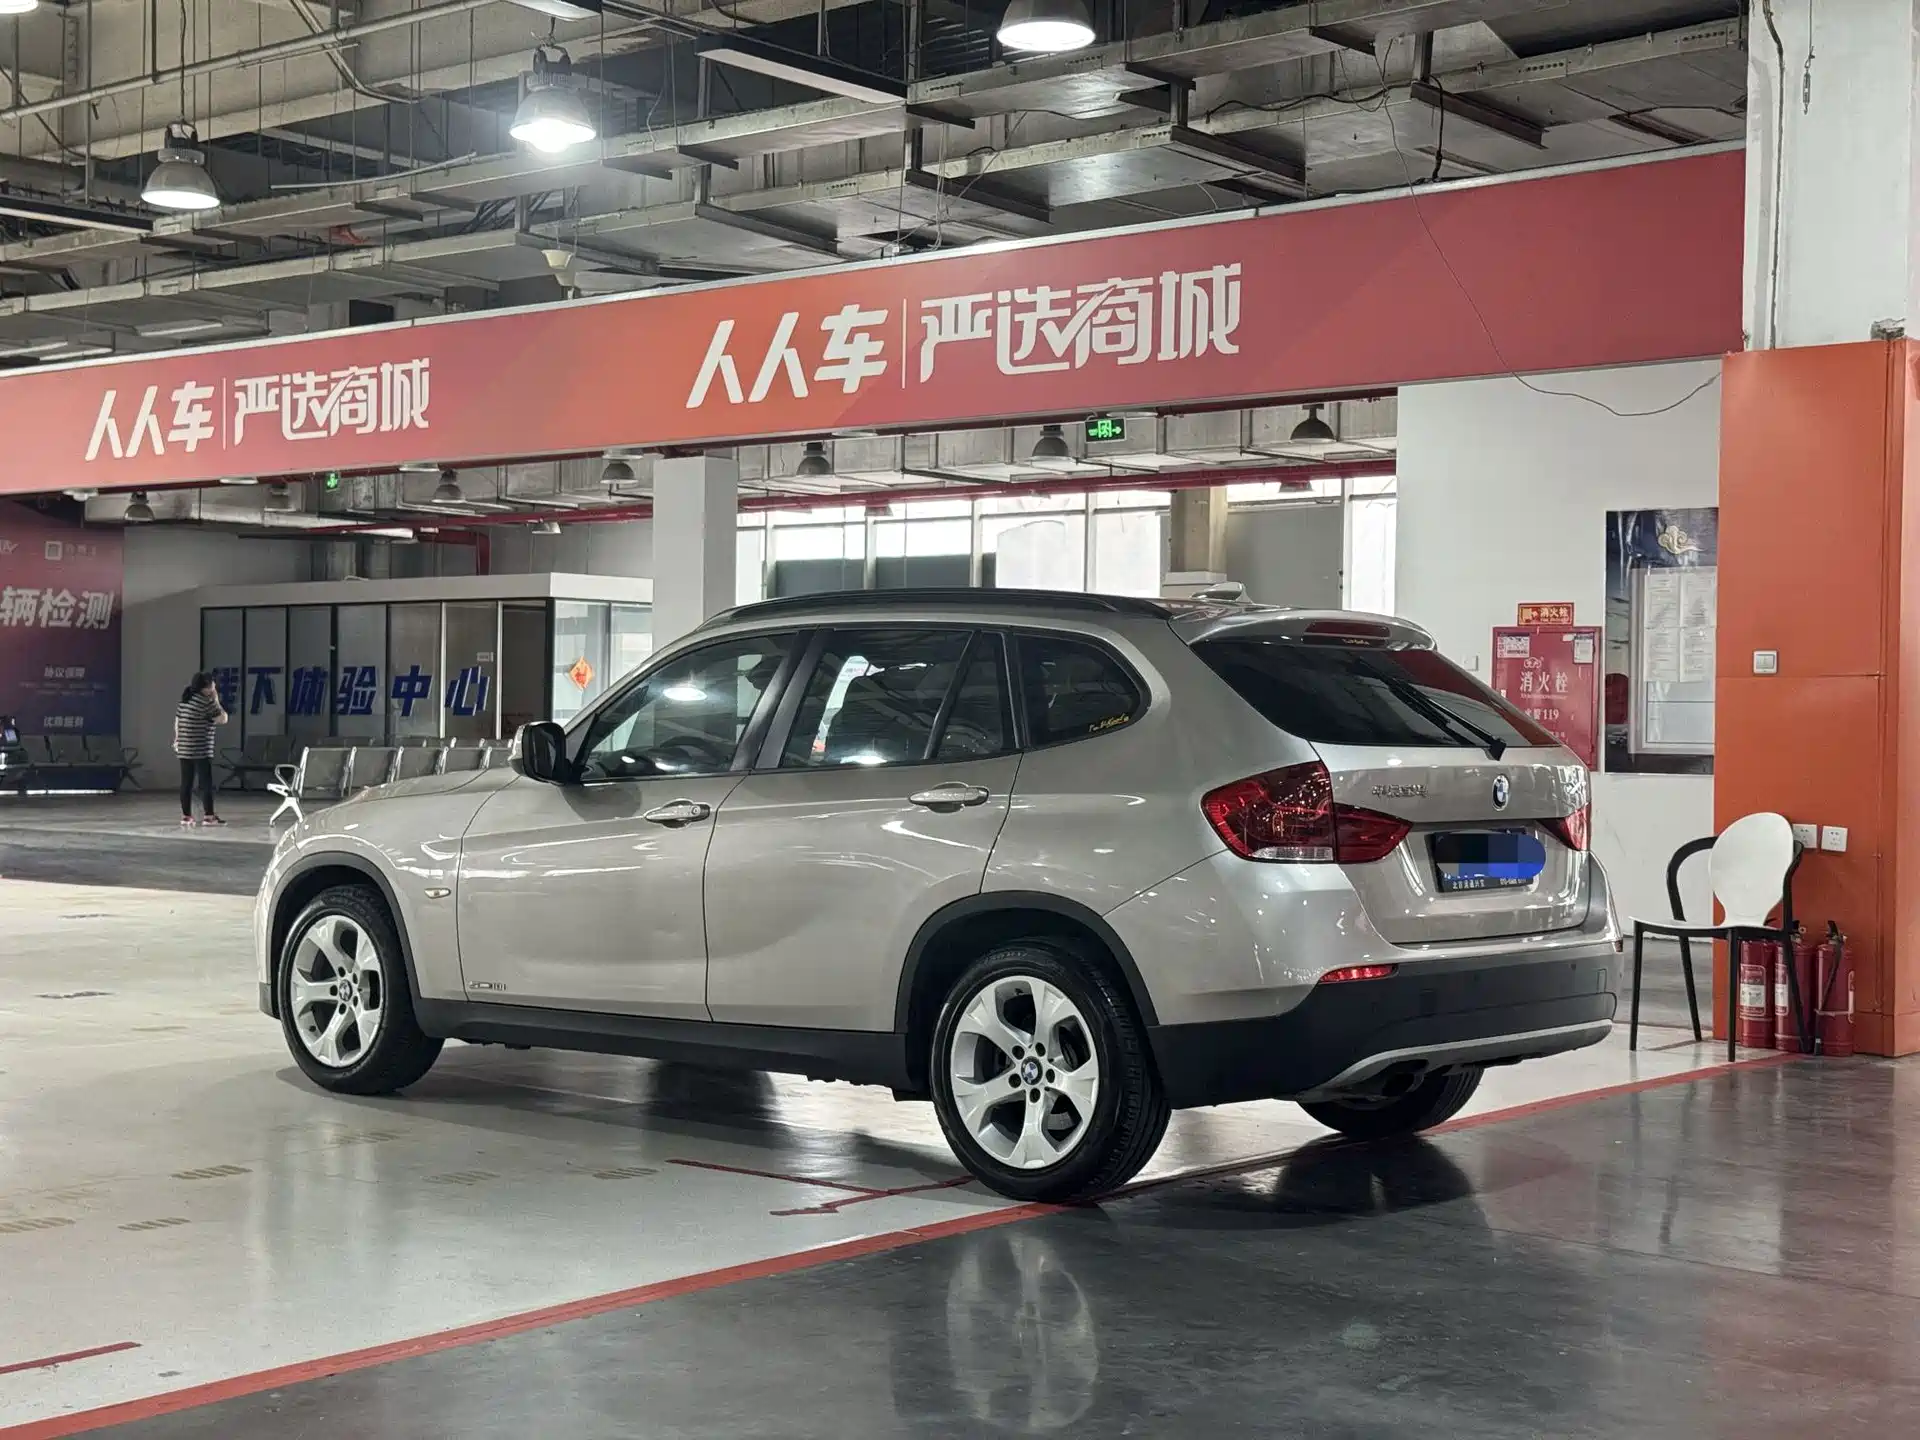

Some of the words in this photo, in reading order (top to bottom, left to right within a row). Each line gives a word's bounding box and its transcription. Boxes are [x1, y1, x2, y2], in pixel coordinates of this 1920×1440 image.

[686, 304, 888, 409] 人人车
[920, 262, 1242, 384] 严选商城
[85, 381, 213, 461] 人人车
[234, 357, 431, 446] 严选商城
[1539, 606, 1569, 618] 消火栓
[211, 665, 490, 717] 线下体验中心
[1520, 671, 1568, 693] 消火栓
